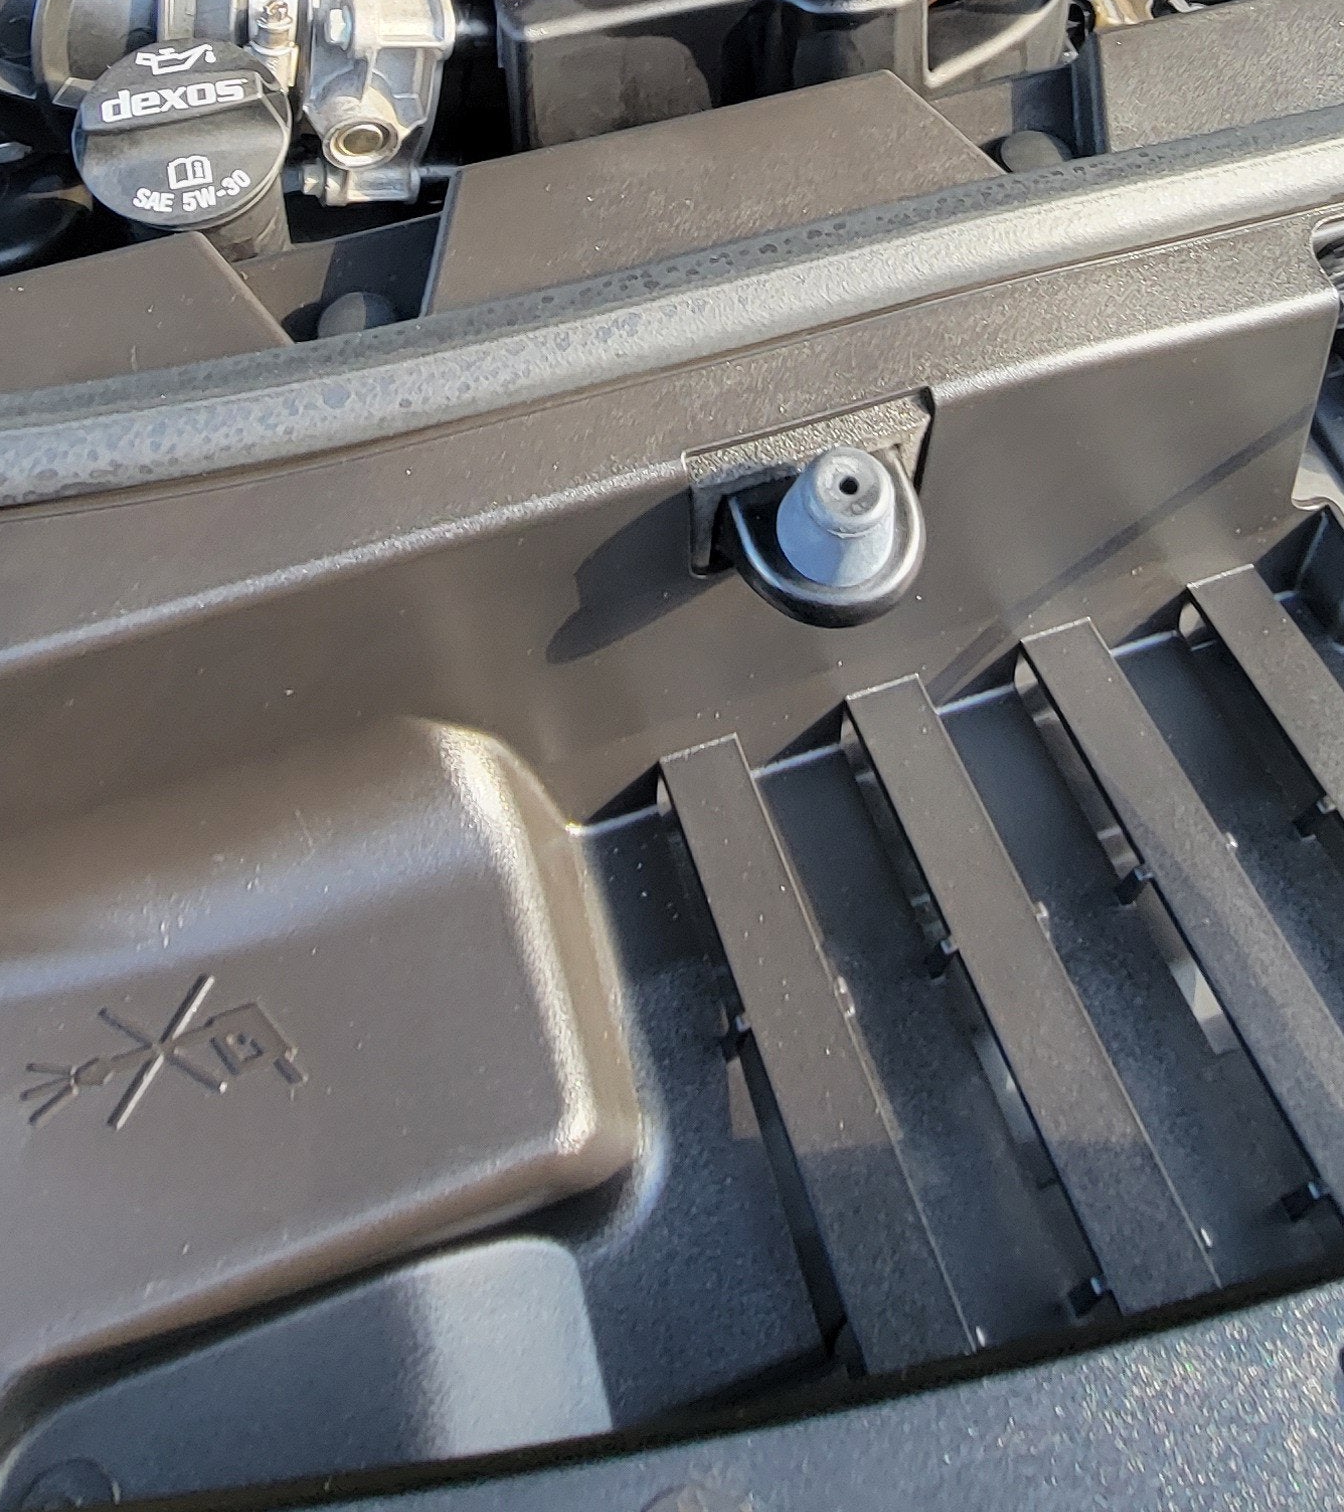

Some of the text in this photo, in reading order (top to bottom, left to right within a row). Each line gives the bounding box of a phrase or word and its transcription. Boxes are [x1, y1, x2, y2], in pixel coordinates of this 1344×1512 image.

[101, 78, 247, 123] dexos
[132, 169, 252, 213] SAE 5W-30
